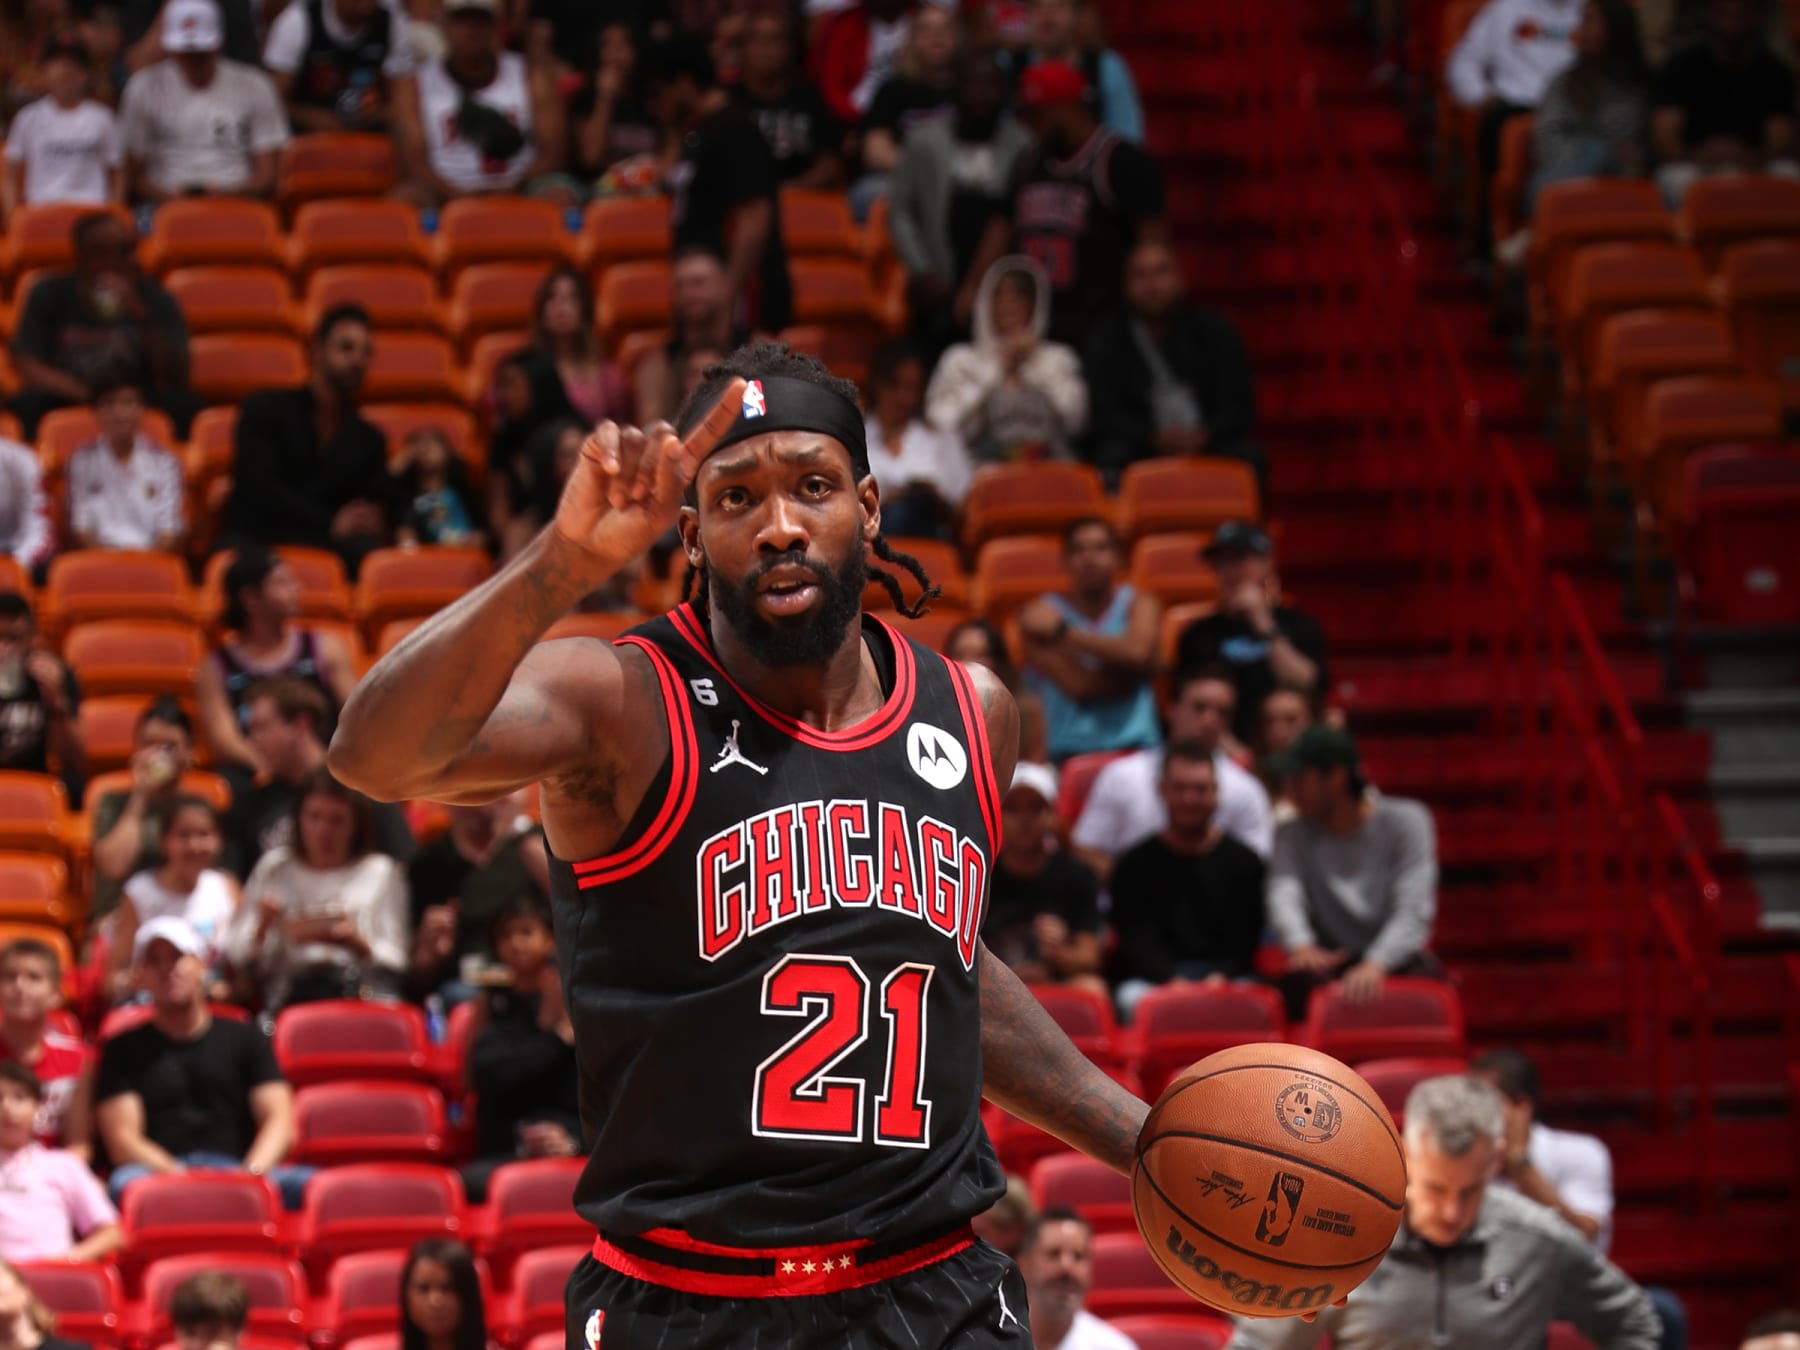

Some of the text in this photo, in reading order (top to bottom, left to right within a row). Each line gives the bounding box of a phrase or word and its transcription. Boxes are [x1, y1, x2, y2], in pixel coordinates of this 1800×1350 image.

[690, 678, 719, 706] 6
[697, 799, 986, 972] CHICAGO
[752, 953, 935, 1149] 21
